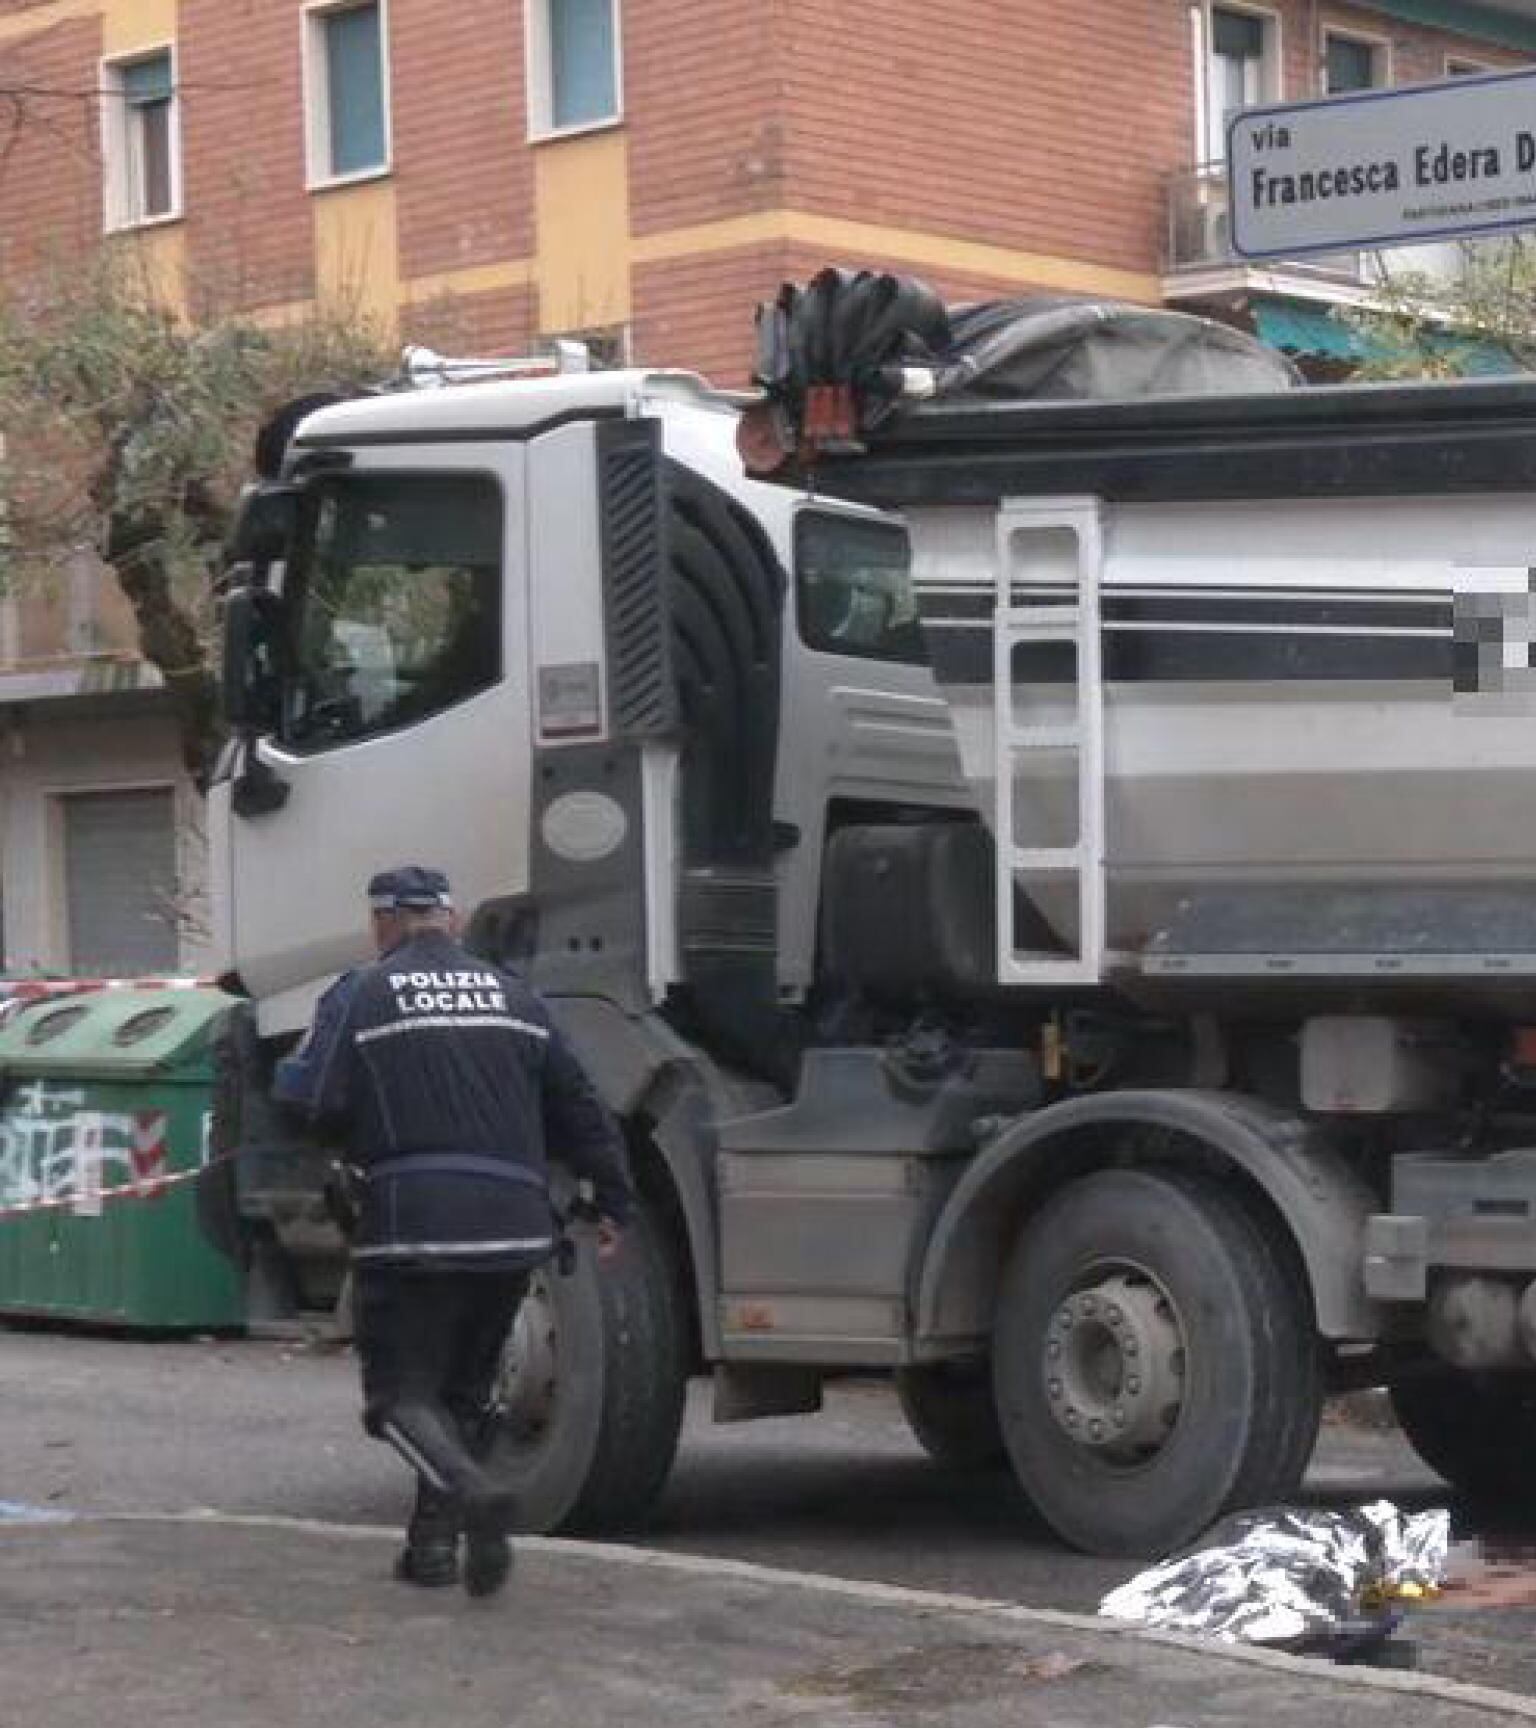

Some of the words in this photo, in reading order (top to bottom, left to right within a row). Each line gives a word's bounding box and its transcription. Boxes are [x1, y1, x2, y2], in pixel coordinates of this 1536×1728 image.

[1252, 124, 1291, 151] via
[1252, 161, 1398, 209] Francesca
[1415, 143, 1499, 187] Edera
[388, 970, 500, 989] POLIZIA
[397, 991, 506, 1011] LOCALE
